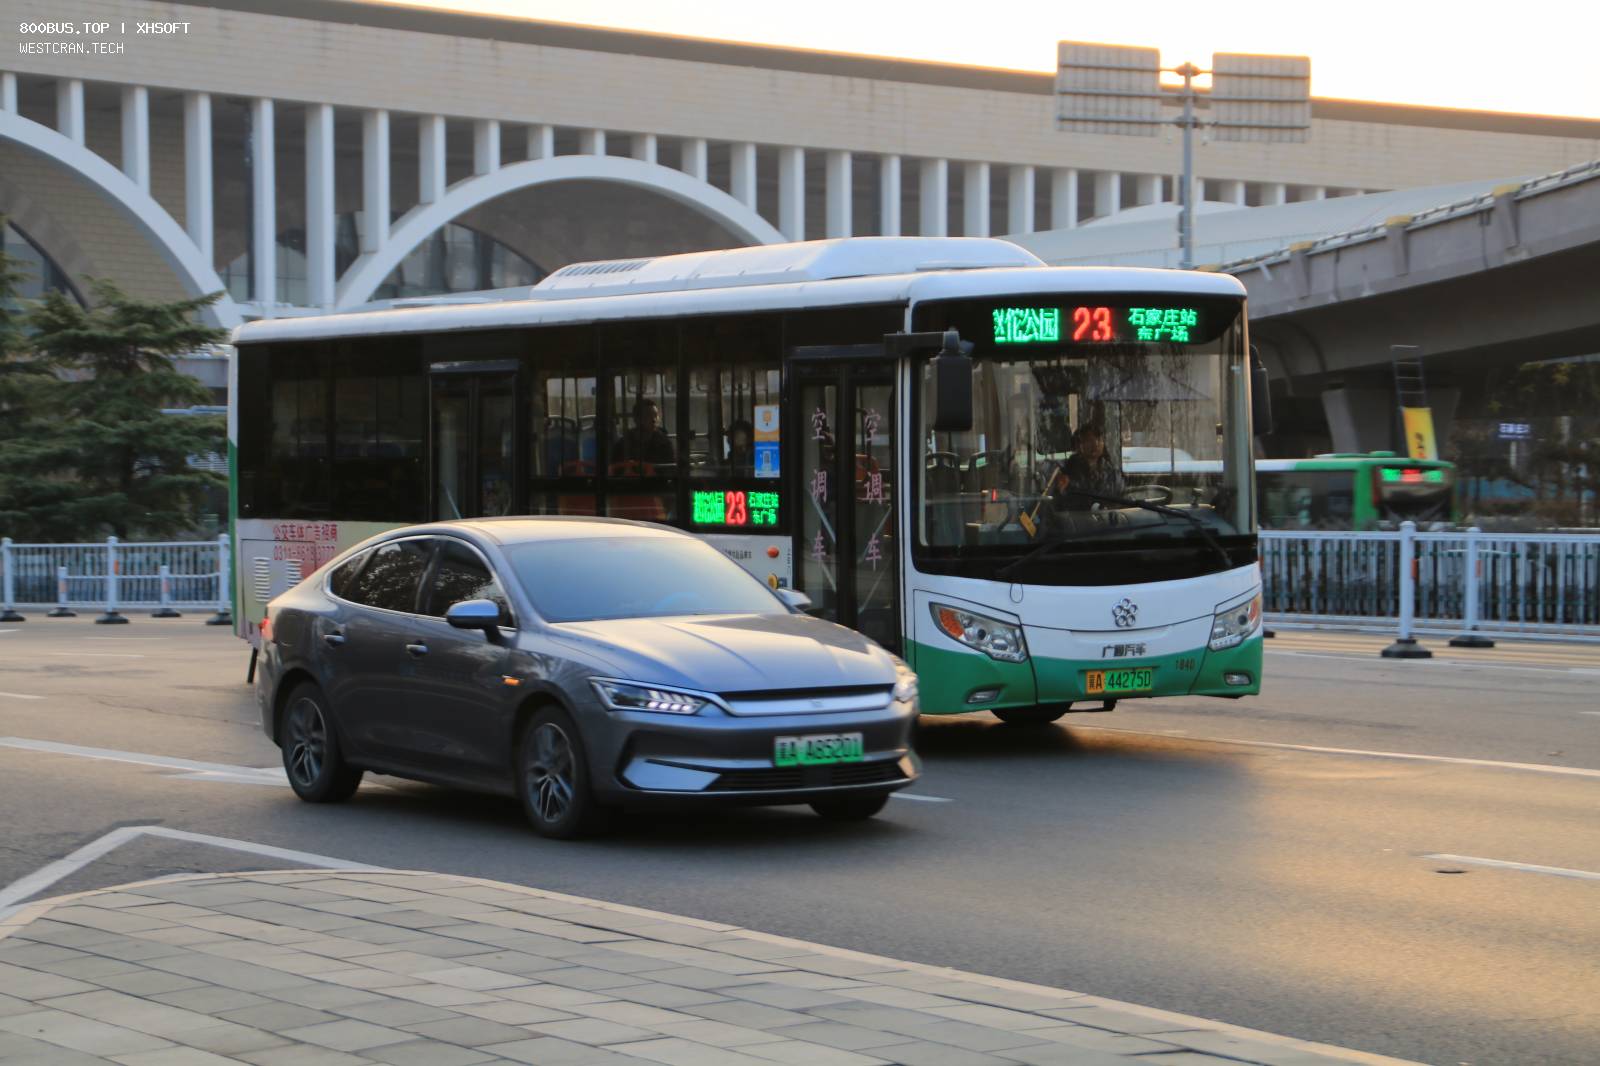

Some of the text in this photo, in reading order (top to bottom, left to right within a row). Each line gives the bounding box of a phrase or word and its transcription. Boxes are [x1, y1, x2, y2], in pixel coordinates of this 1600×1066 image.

[1072, 307, 1111, 341] 23
[1128, 307, 1198, 326] 石家庄站
[1137, 325, 1189, 342] 东广场
[811, 407, 827, 567] 空调车
[864, 407, 882, 571] 空调车
[725, 490, 747, 525] 23
